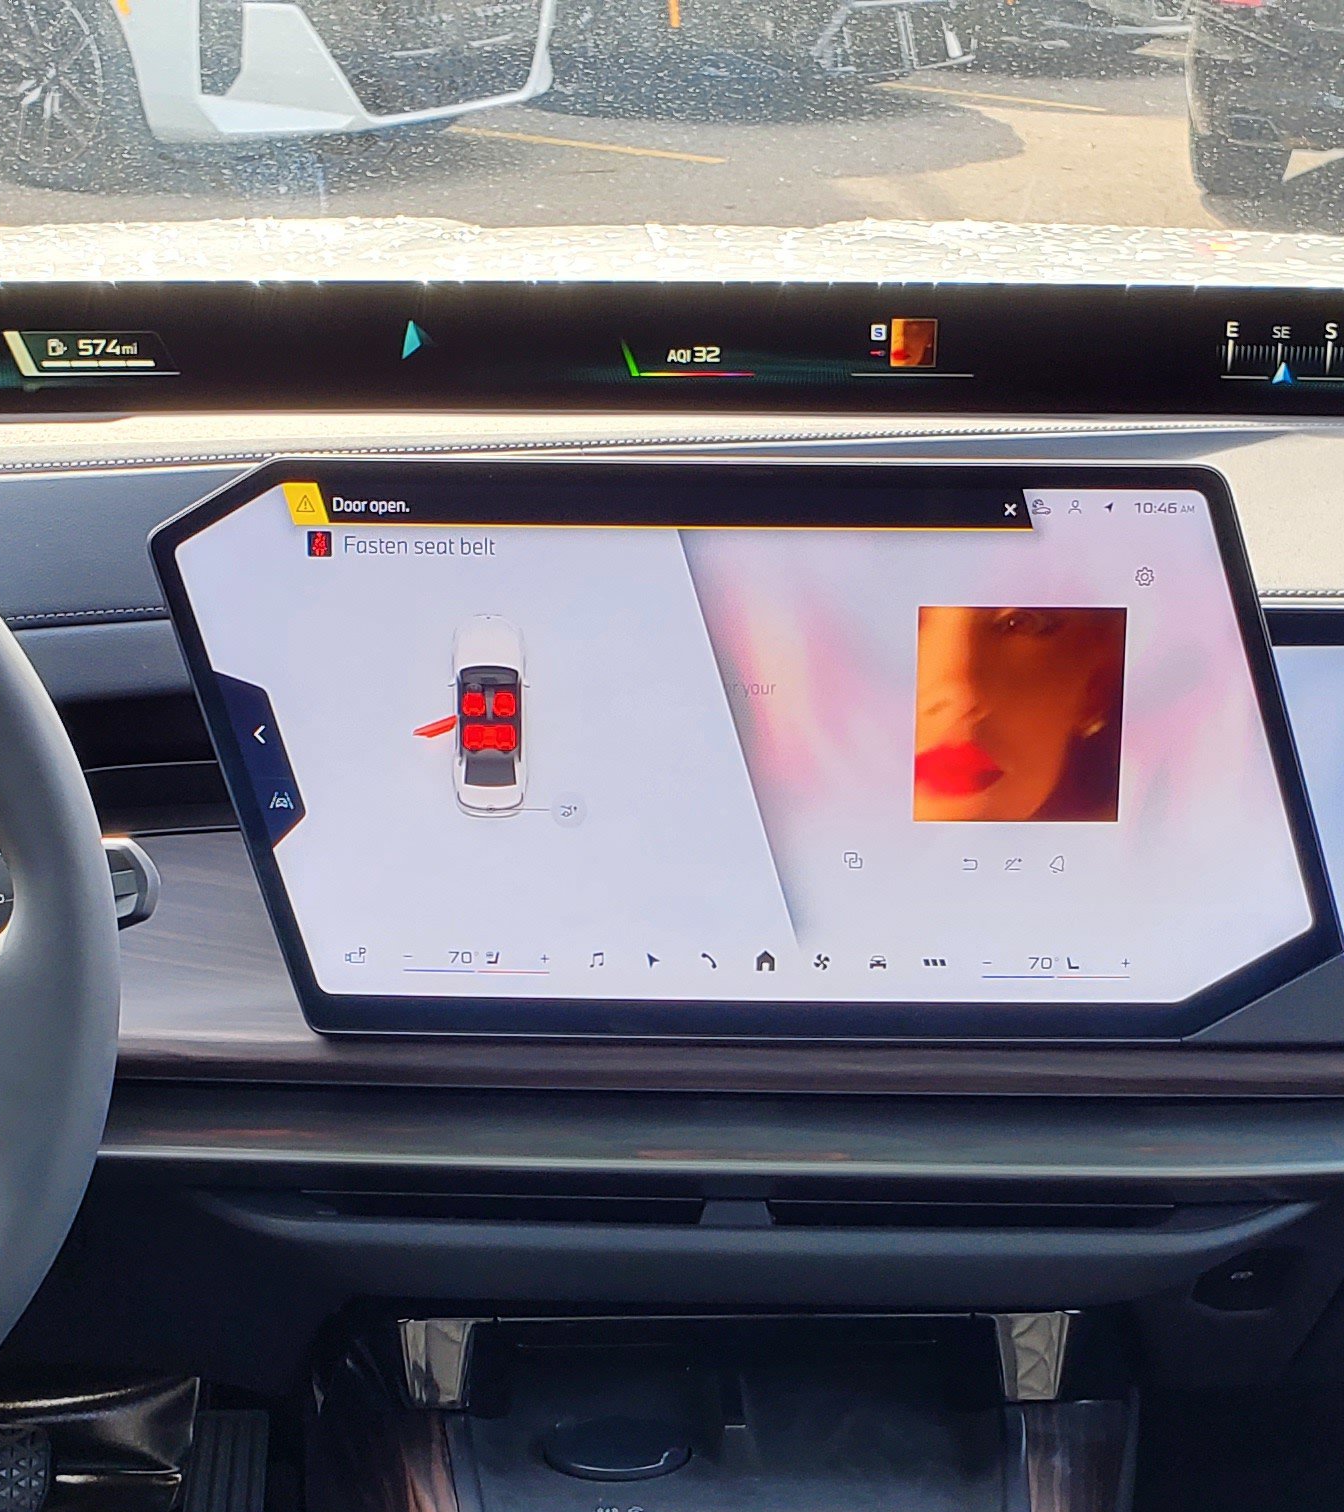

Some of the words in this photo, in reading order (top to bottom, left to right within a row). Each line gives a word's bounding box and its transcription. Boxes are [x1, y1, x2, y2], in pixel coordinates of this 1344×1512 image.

[1226, 321, 1240, 338] E
[1272, 325, 1292, 339] SE
[1324, 322, 1338, 339] S
[666, 349, 692, 364] AQI
[693, 346, 721, 363] 32
[332, 497, 368, 513] Door
[369, 499, 410, 515] open.
[1134, 502, 1177, 514] 10:46
[1180, 504, 1195, 514] AM
[344, 535, 407, 554] Fasten
[414, 538, 455, 555] seat
[460, 536, 496, 555] belt
[743, 683, 777, 698] your
